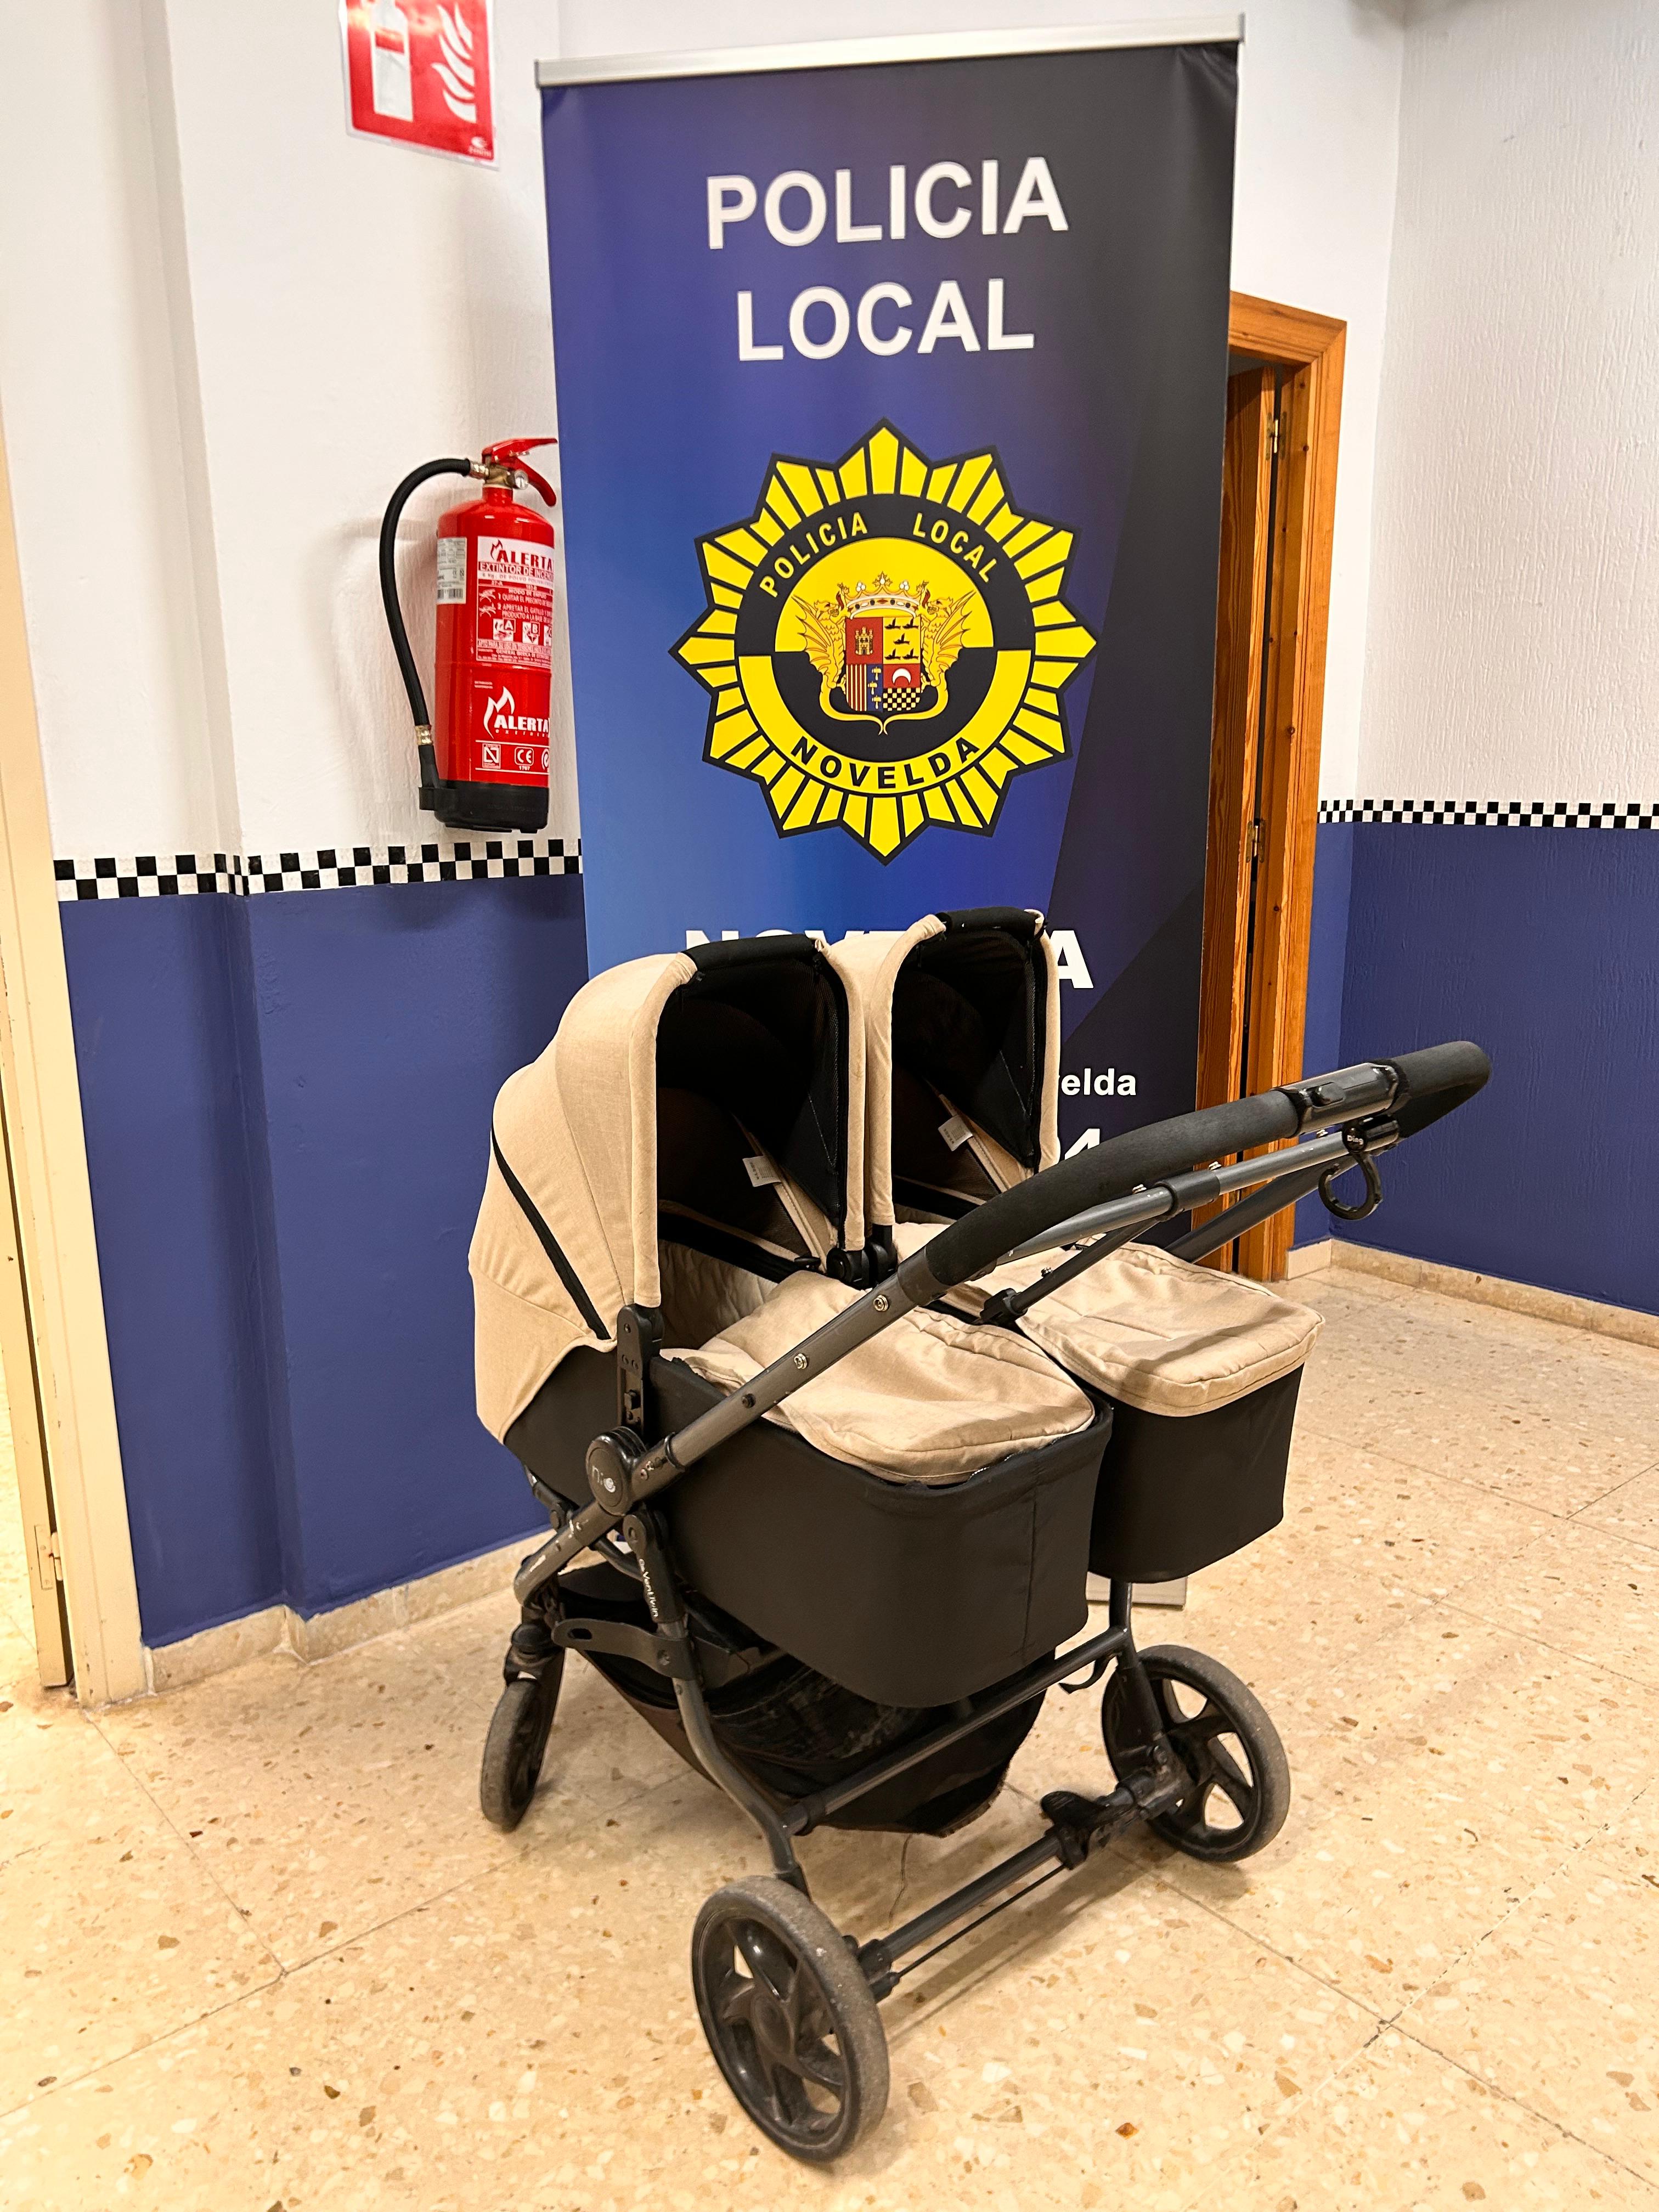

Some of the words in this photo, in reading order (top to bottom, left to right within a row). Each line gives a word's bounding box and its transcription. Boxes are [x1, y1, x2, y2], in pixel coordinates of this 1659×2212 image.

[706, 156, 1069, 250] POLICIA
[737, 278, 1035, 362] LOCAL
[496, 550, 552, 572] ALERTA
[759, 512, 868, 597] POLICIA
[913, 512, 999, 583] LOCAL
[480, 562, 522, 576] EXTINTOR
[523, 567, 534, 577] DE
[504, 619, 514, 631] A
[532, 623, 538, 634] B
[494, 714, 549, 733] ALERTA
[517, 749, 532, 764] CE
[790, 735, 980, 789] NOVELDA
[1059, 1068, 1136, 1096] elda
